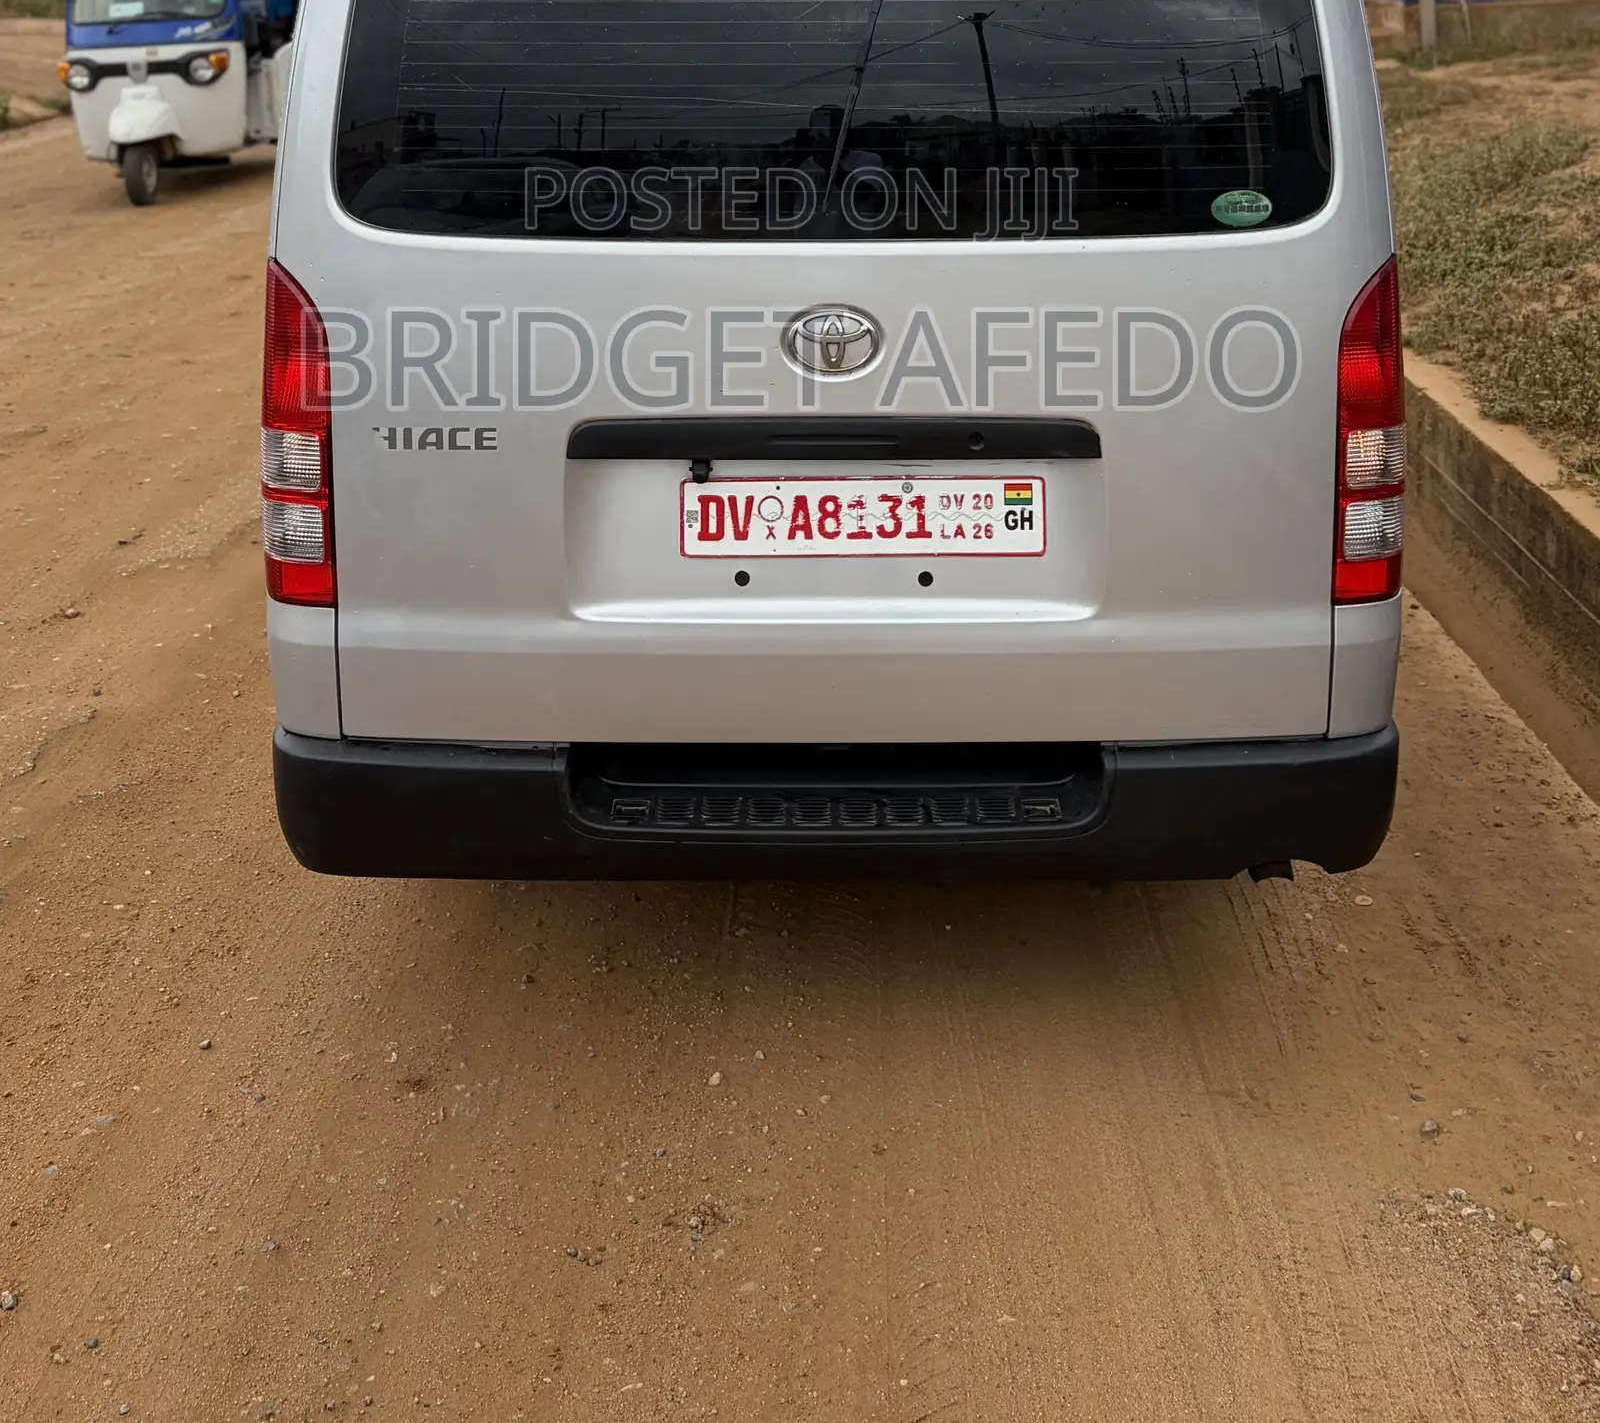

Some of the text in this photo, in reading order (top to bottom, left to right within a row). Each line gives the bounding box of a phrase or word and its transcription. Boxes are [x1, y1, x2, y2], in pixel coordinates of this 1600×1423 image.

[939, 493, 994, 510] DV 20
[697, 493, 933, 541] DV A8131
[1004, 509, 1034, 531] GH
[972, 523, 994, 540] 26
